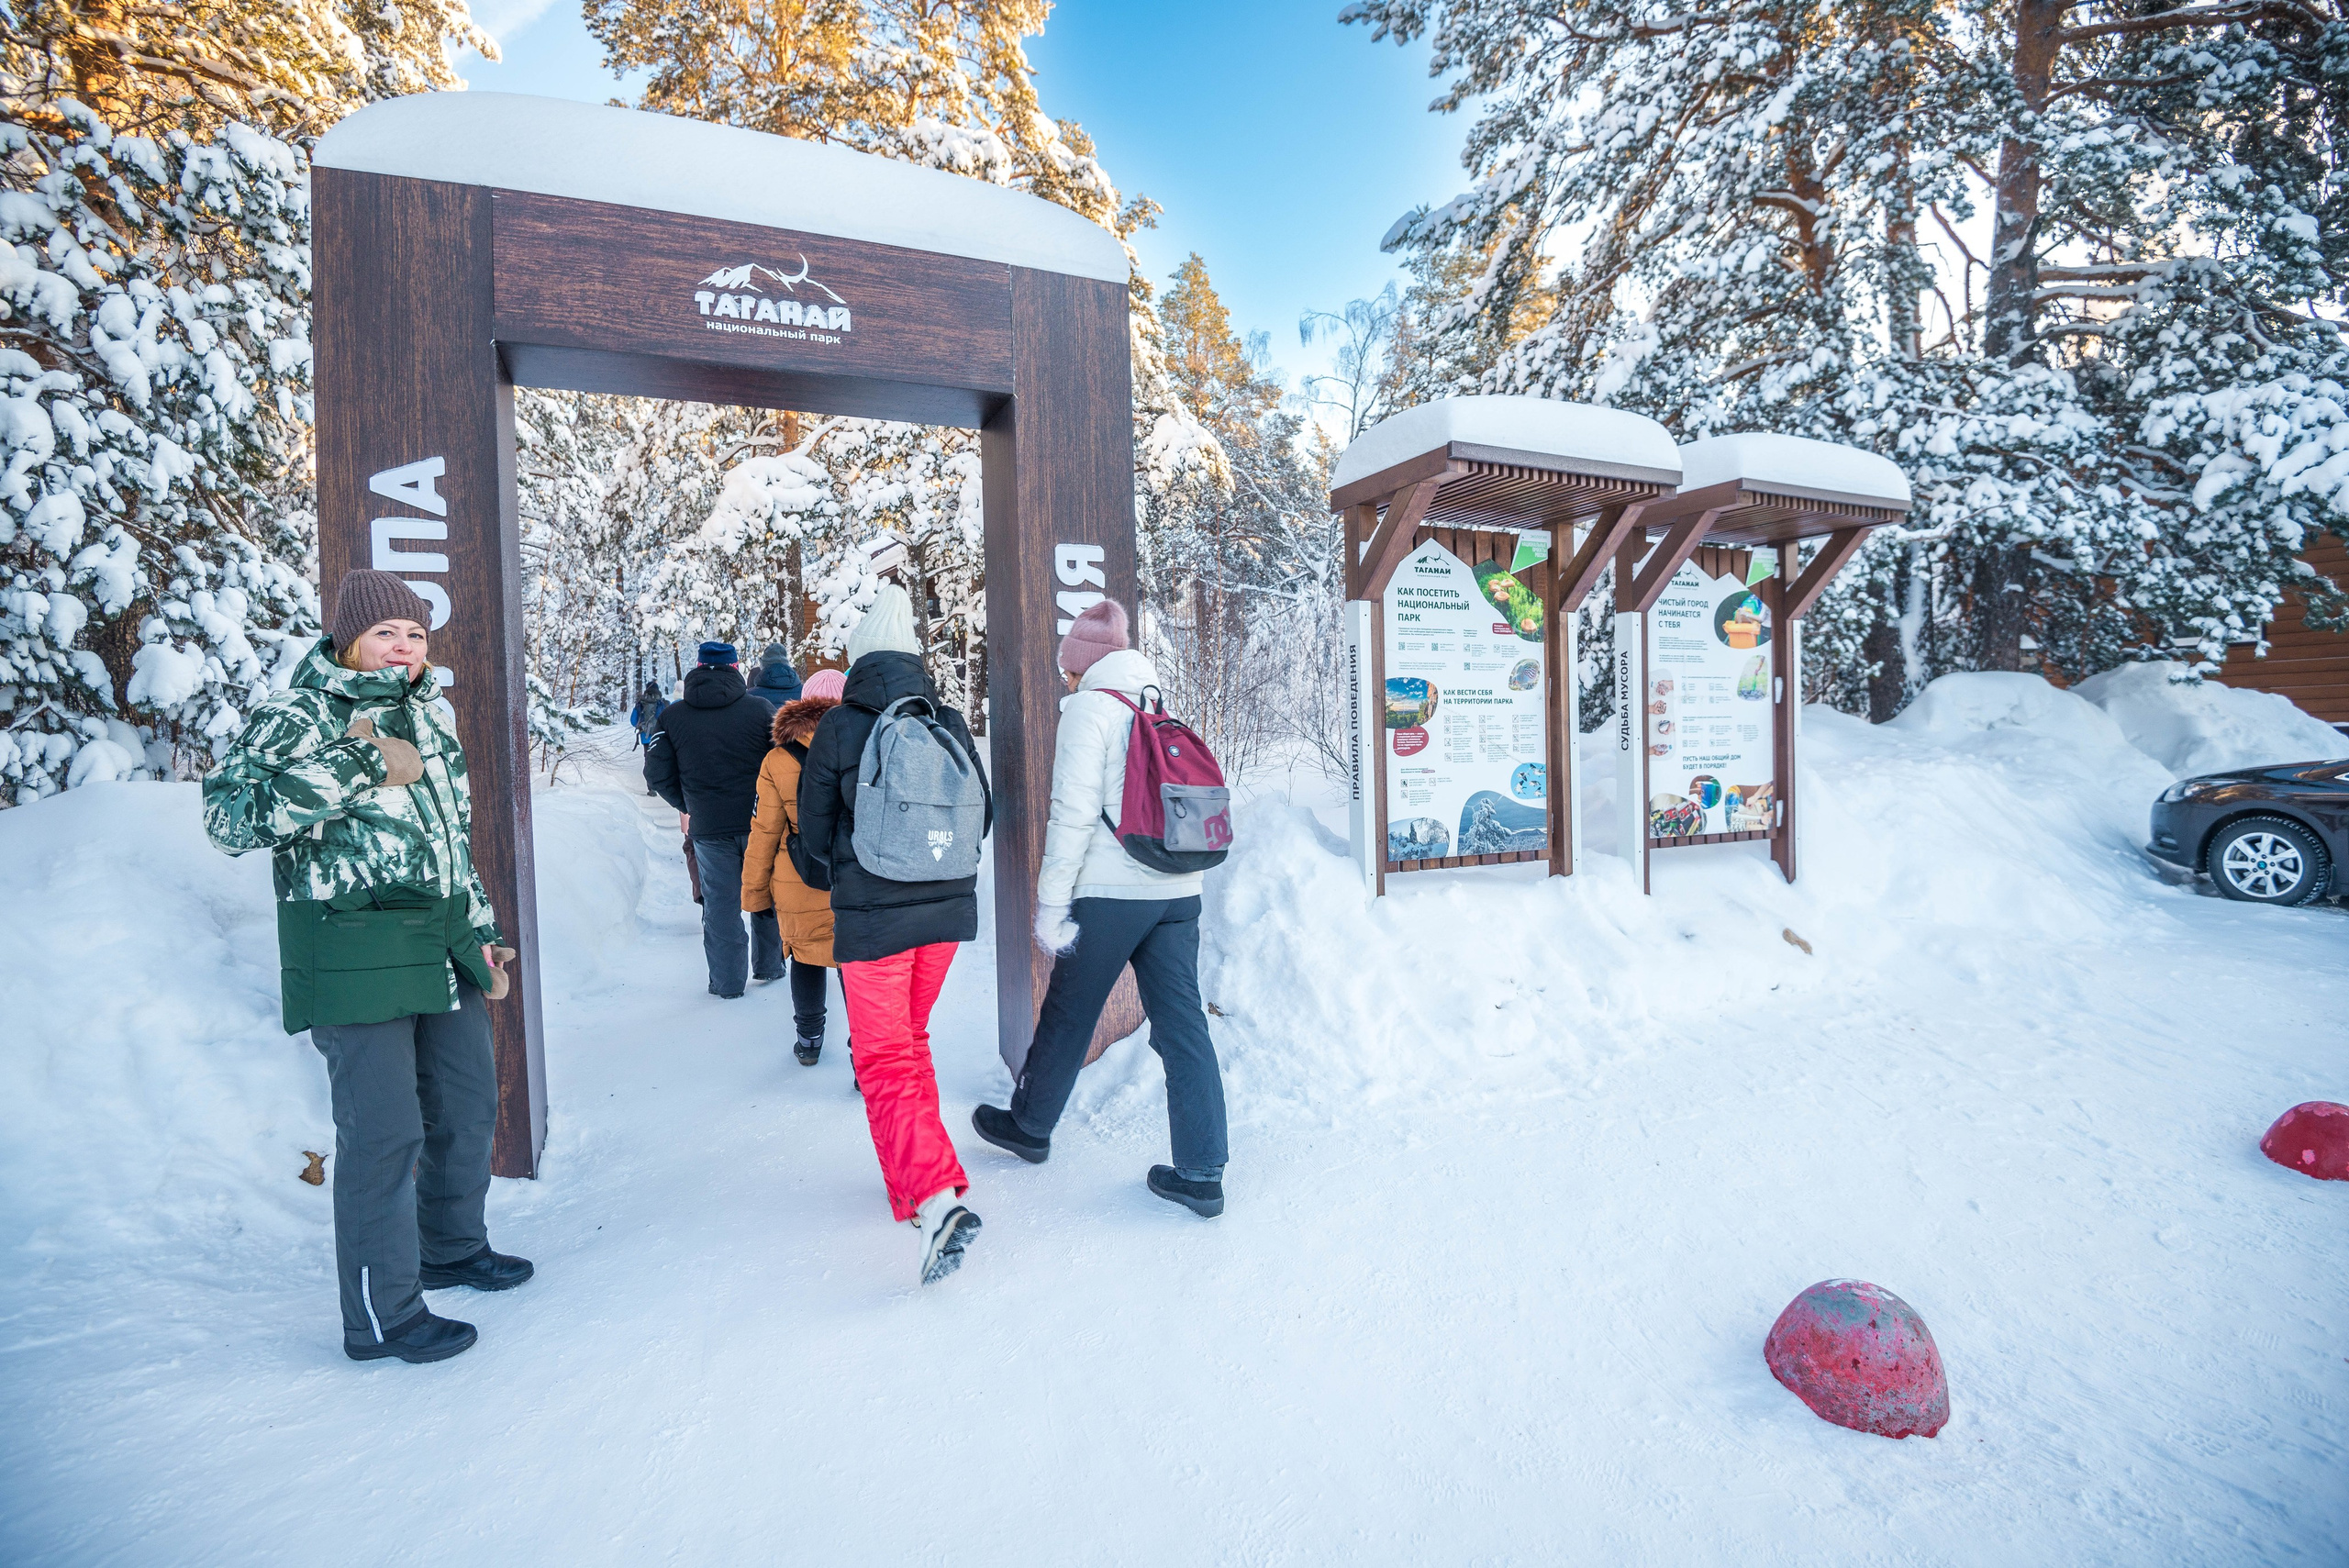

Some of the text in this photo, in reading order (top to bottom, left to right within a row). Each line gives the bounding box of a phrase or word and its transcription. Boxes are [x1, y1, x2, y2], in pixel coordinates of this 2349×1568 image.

[706, 321, 841, 345] национальный парк
[1397, 587, 1460, 598] КАК ПОСЕТИТЬ
[1397, 599, 1470, 611] НАЦИОНАЛЬНЫЙ
[1658, 597, 1709, 609] ЧИСТЫЙ ГОРОД
[1397, 613, 1420, 622] ПАРК
[1658, 609, 1701, 618] НАЧИНАЕТСЯ
[1664, 620, 1681, 628] ТЕБЯ
[1620, 651, 1631, 751] СУДЬБА МУСОРА
[1350, 644, 1360, 800] ПРАВИЛА ПОВЕДЕНИЯ
[928, 829, 953, 842] URALS
